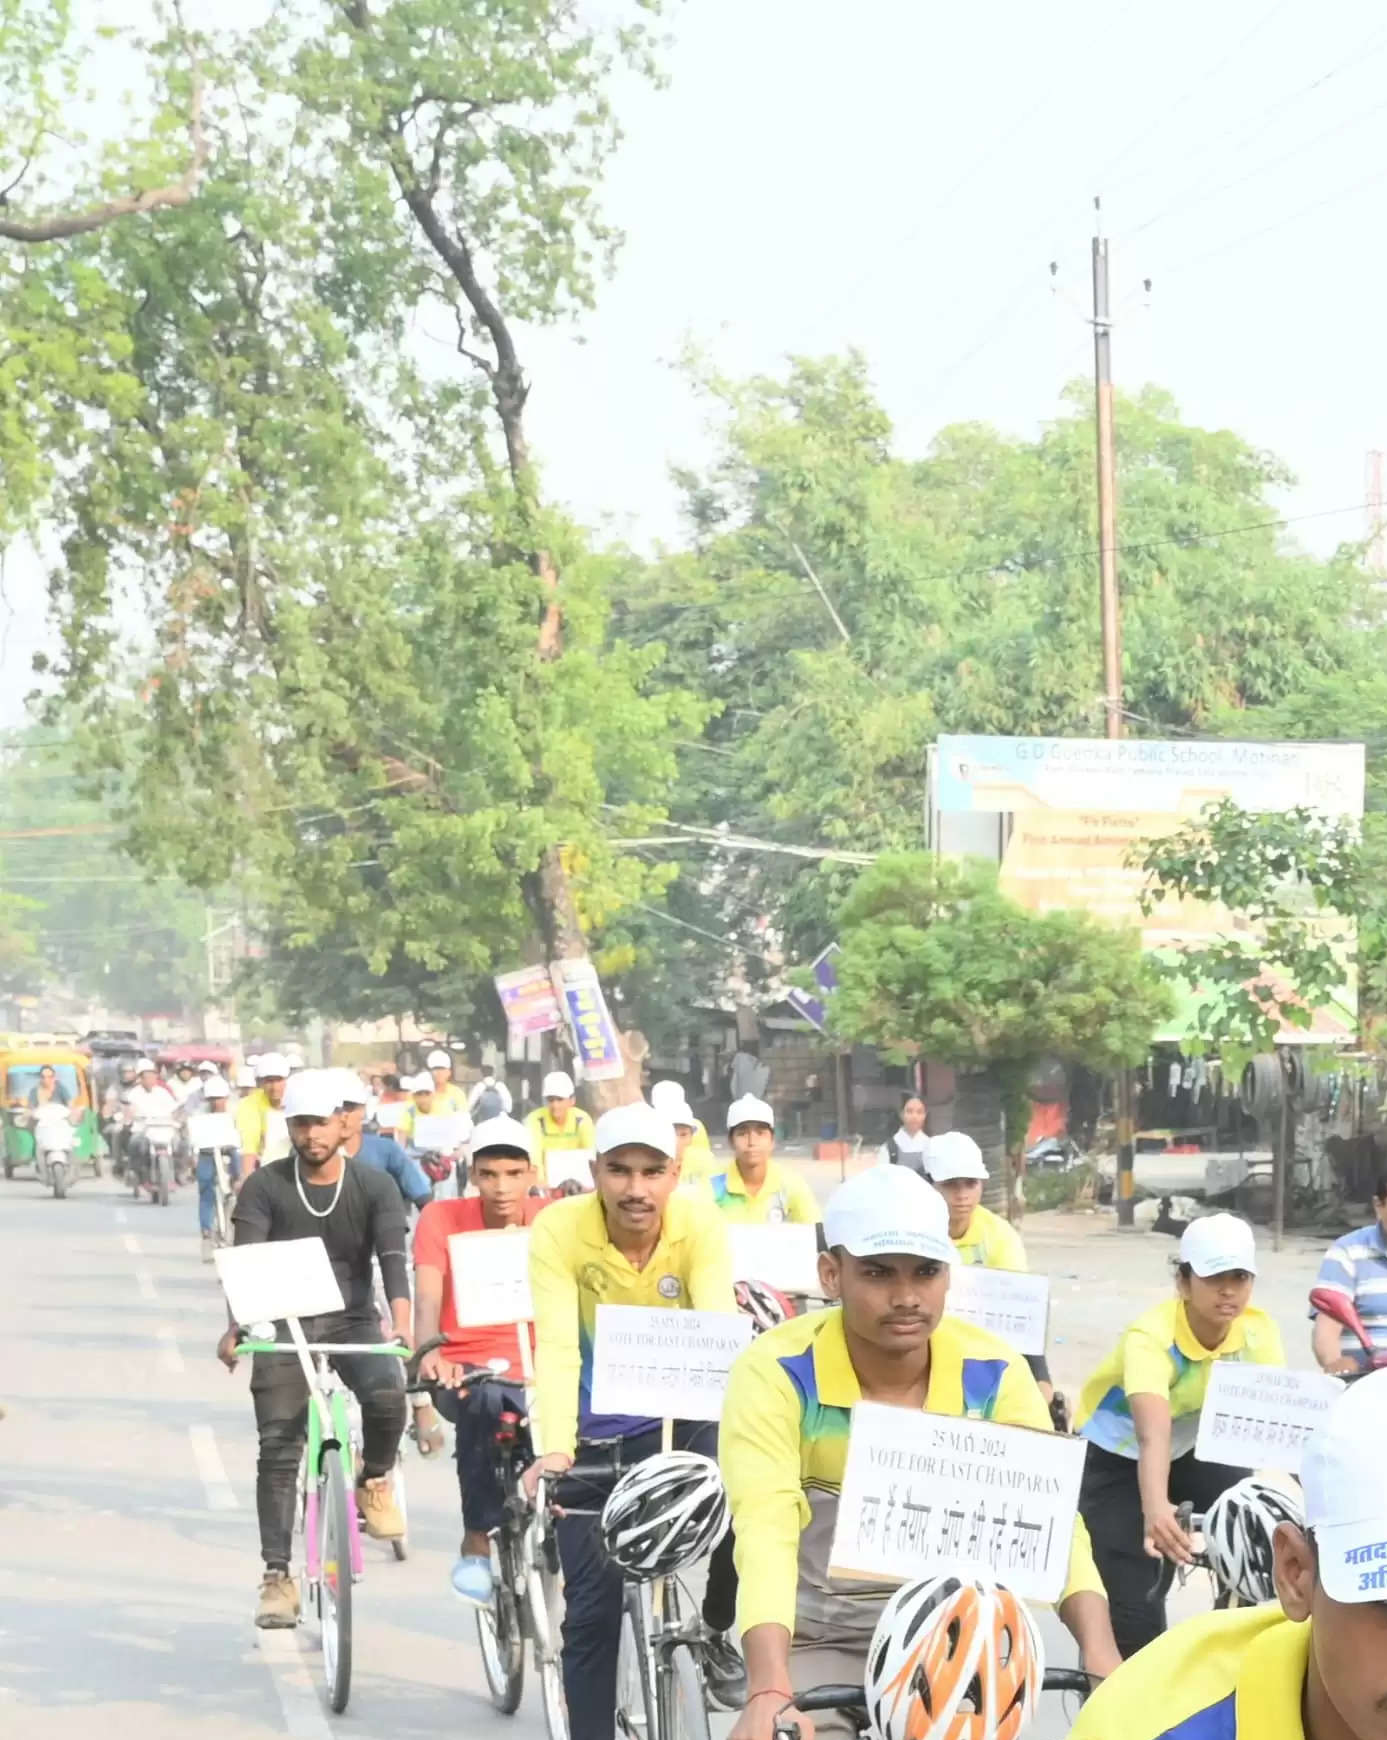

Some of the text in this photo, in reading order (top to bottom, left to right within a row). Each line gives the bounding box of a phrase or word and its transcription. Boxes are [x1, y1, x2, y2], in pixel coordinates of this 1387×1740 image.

[869, 1446, 906, 1470] VOTE
[908, 1453, 937, 1475] FOR
[939, 1458, 975, 1481] EAST
